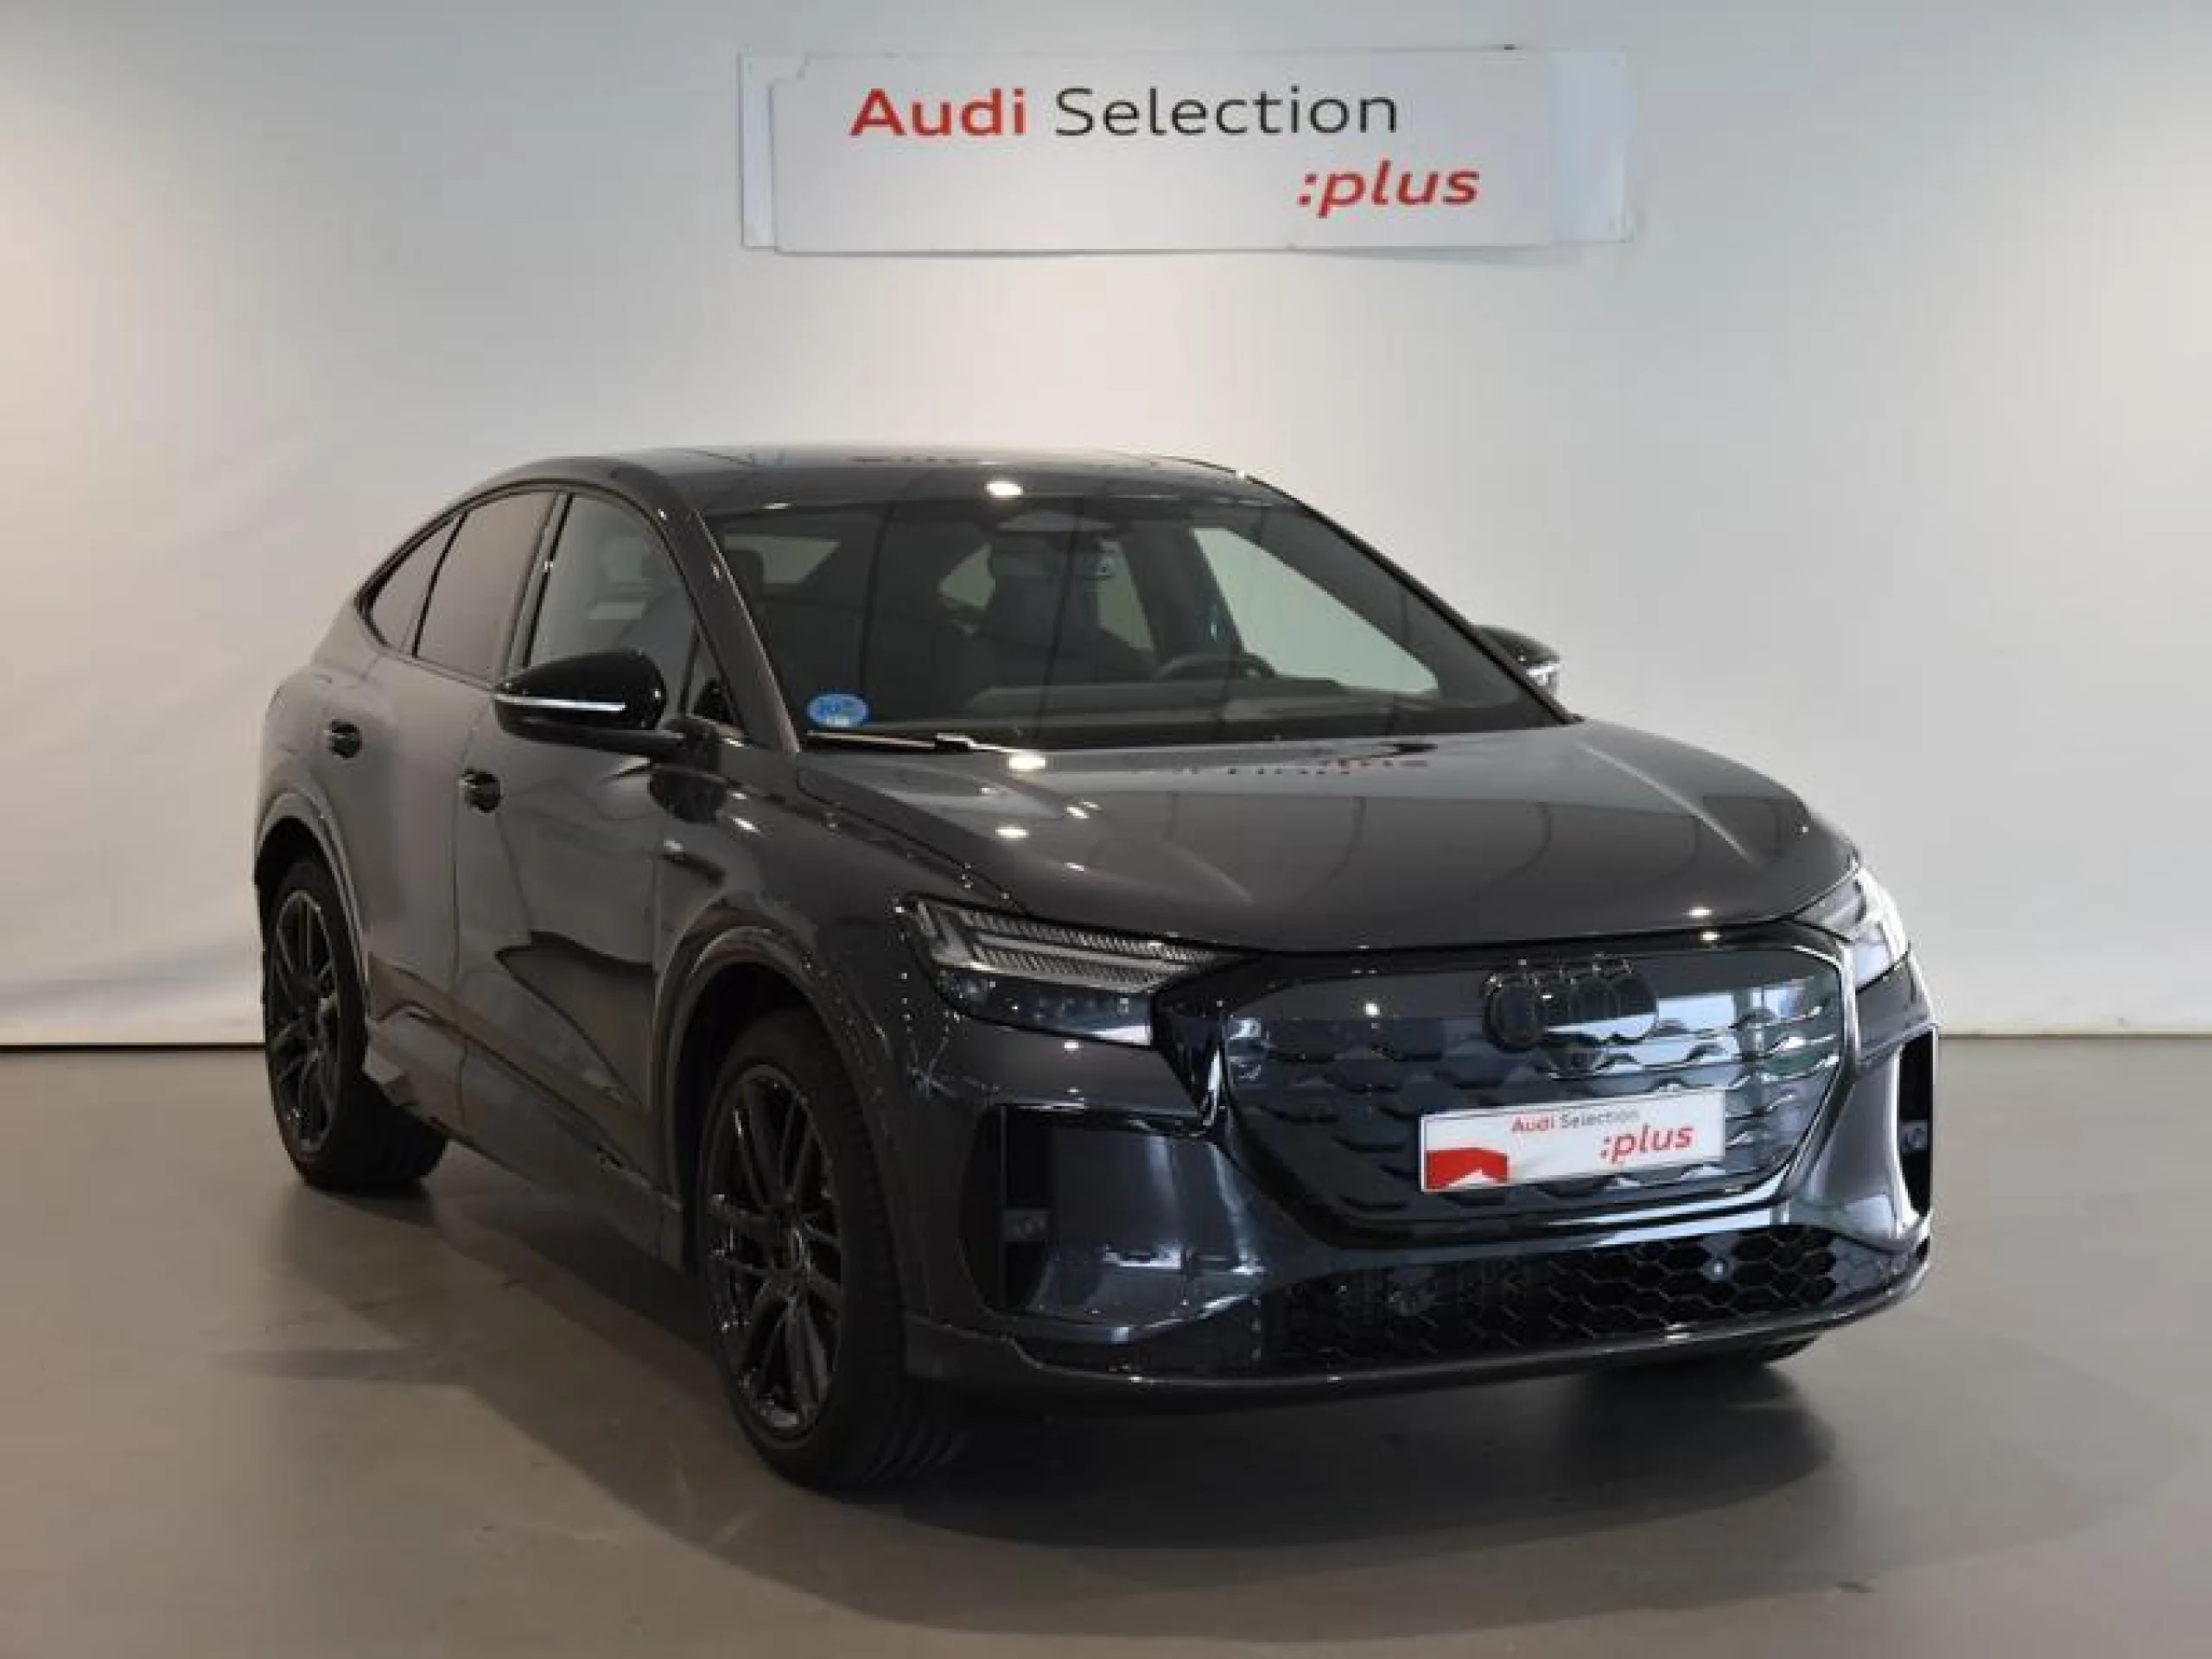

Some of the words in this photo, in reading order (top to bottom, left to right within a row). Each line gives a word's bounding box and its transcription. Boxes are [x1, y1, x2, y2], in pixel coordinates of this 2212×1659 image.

[850, 88, 1027, 137] Audi
[1054, 86, 1397, 136] Selection
[1297, 160, 1480, 217] :plus
[1512, 1115, 1554, 1133] Audi
[1559, 1109, 1639, 1128] Selection
[1600, 1125, 1694, 1163] :plus
